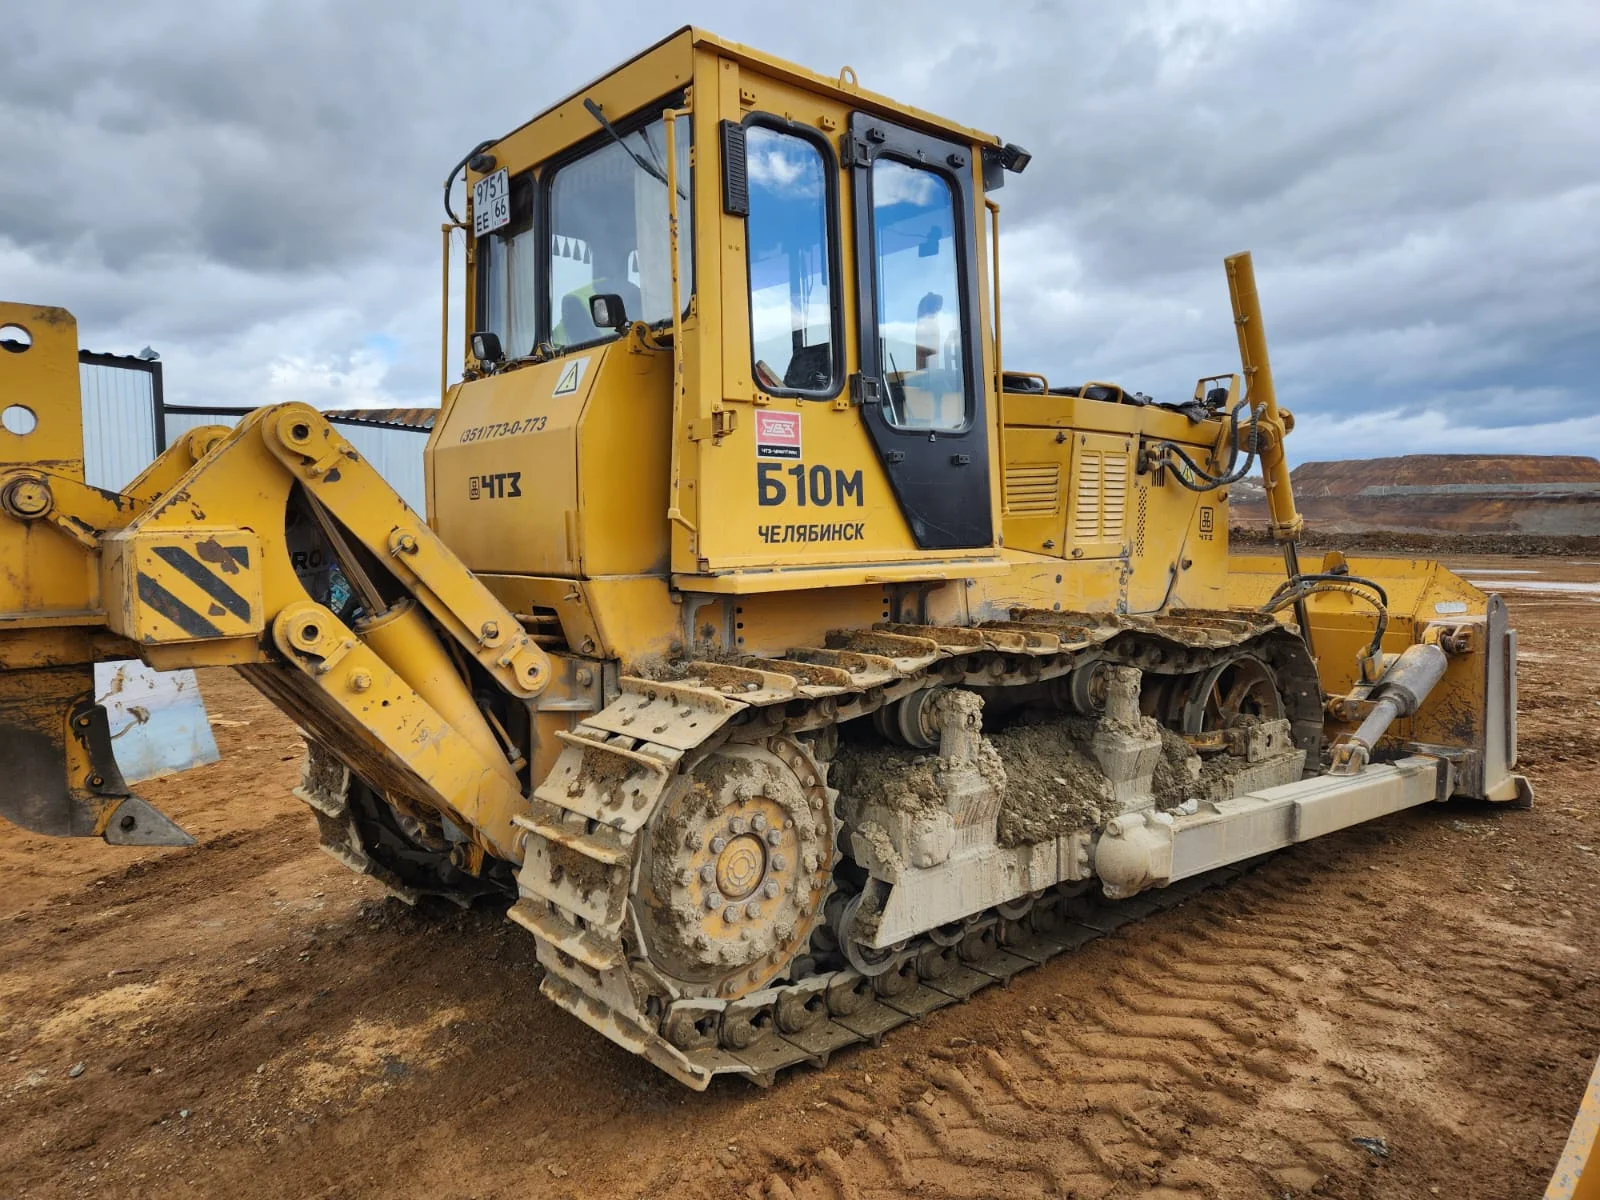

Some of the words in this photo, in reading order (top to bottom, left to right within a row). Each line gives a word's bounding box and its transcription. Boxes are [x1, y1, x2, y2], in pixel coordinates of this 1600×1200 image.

[477, 172, 503, 205] 9751
[476, 211, 489, 232] ЕЕ
[495, 198, 507, 218] 66
[460, 416, 548, 443] (351)773-0-773
[481, 472, 522, 499] ЧТЗ
[757, 462, 864, 507] Б10М
[758, 523, 865, 543] ЧЕЛЯБИНСК
